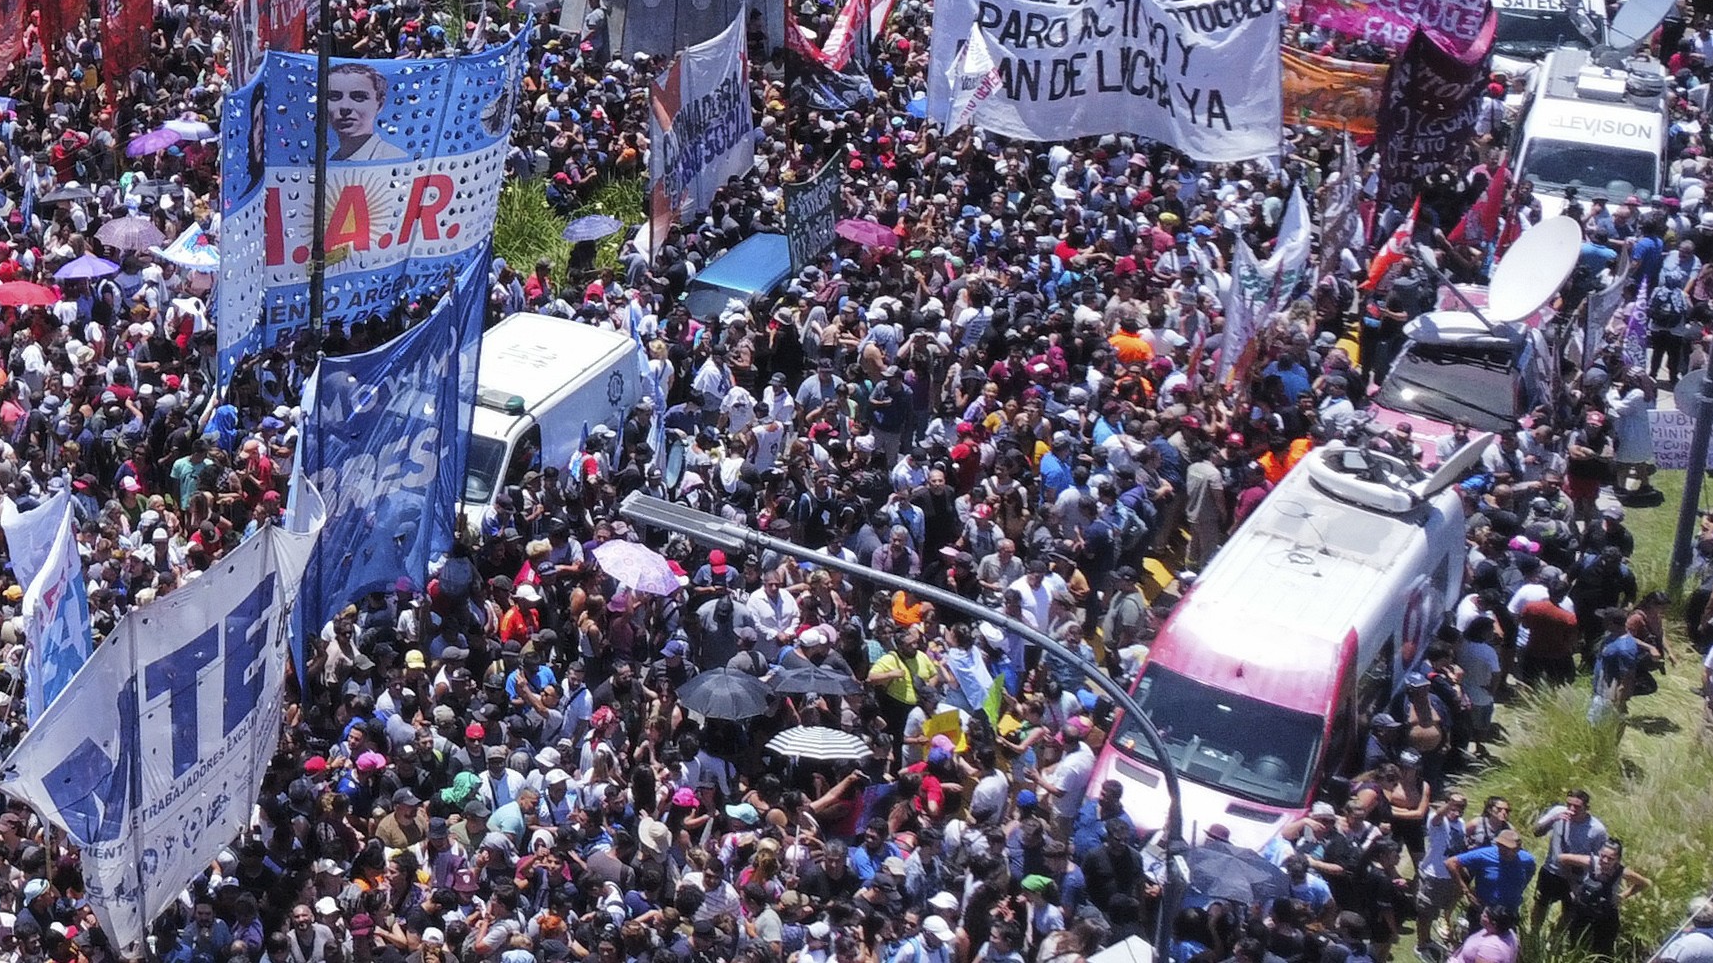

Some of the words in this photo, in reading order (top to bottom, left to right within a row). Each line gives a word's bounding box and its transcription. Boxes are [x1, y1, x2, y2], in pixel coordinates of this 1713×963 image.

[976, 0, 1069, 49] PARO
[1048, 52, 1087, 102] DE
[1177, 82, 1233, 131] YA
[1650, 427, 1696, 440] MINIM
[141, 748, 226, 824] TRABAJADORES
